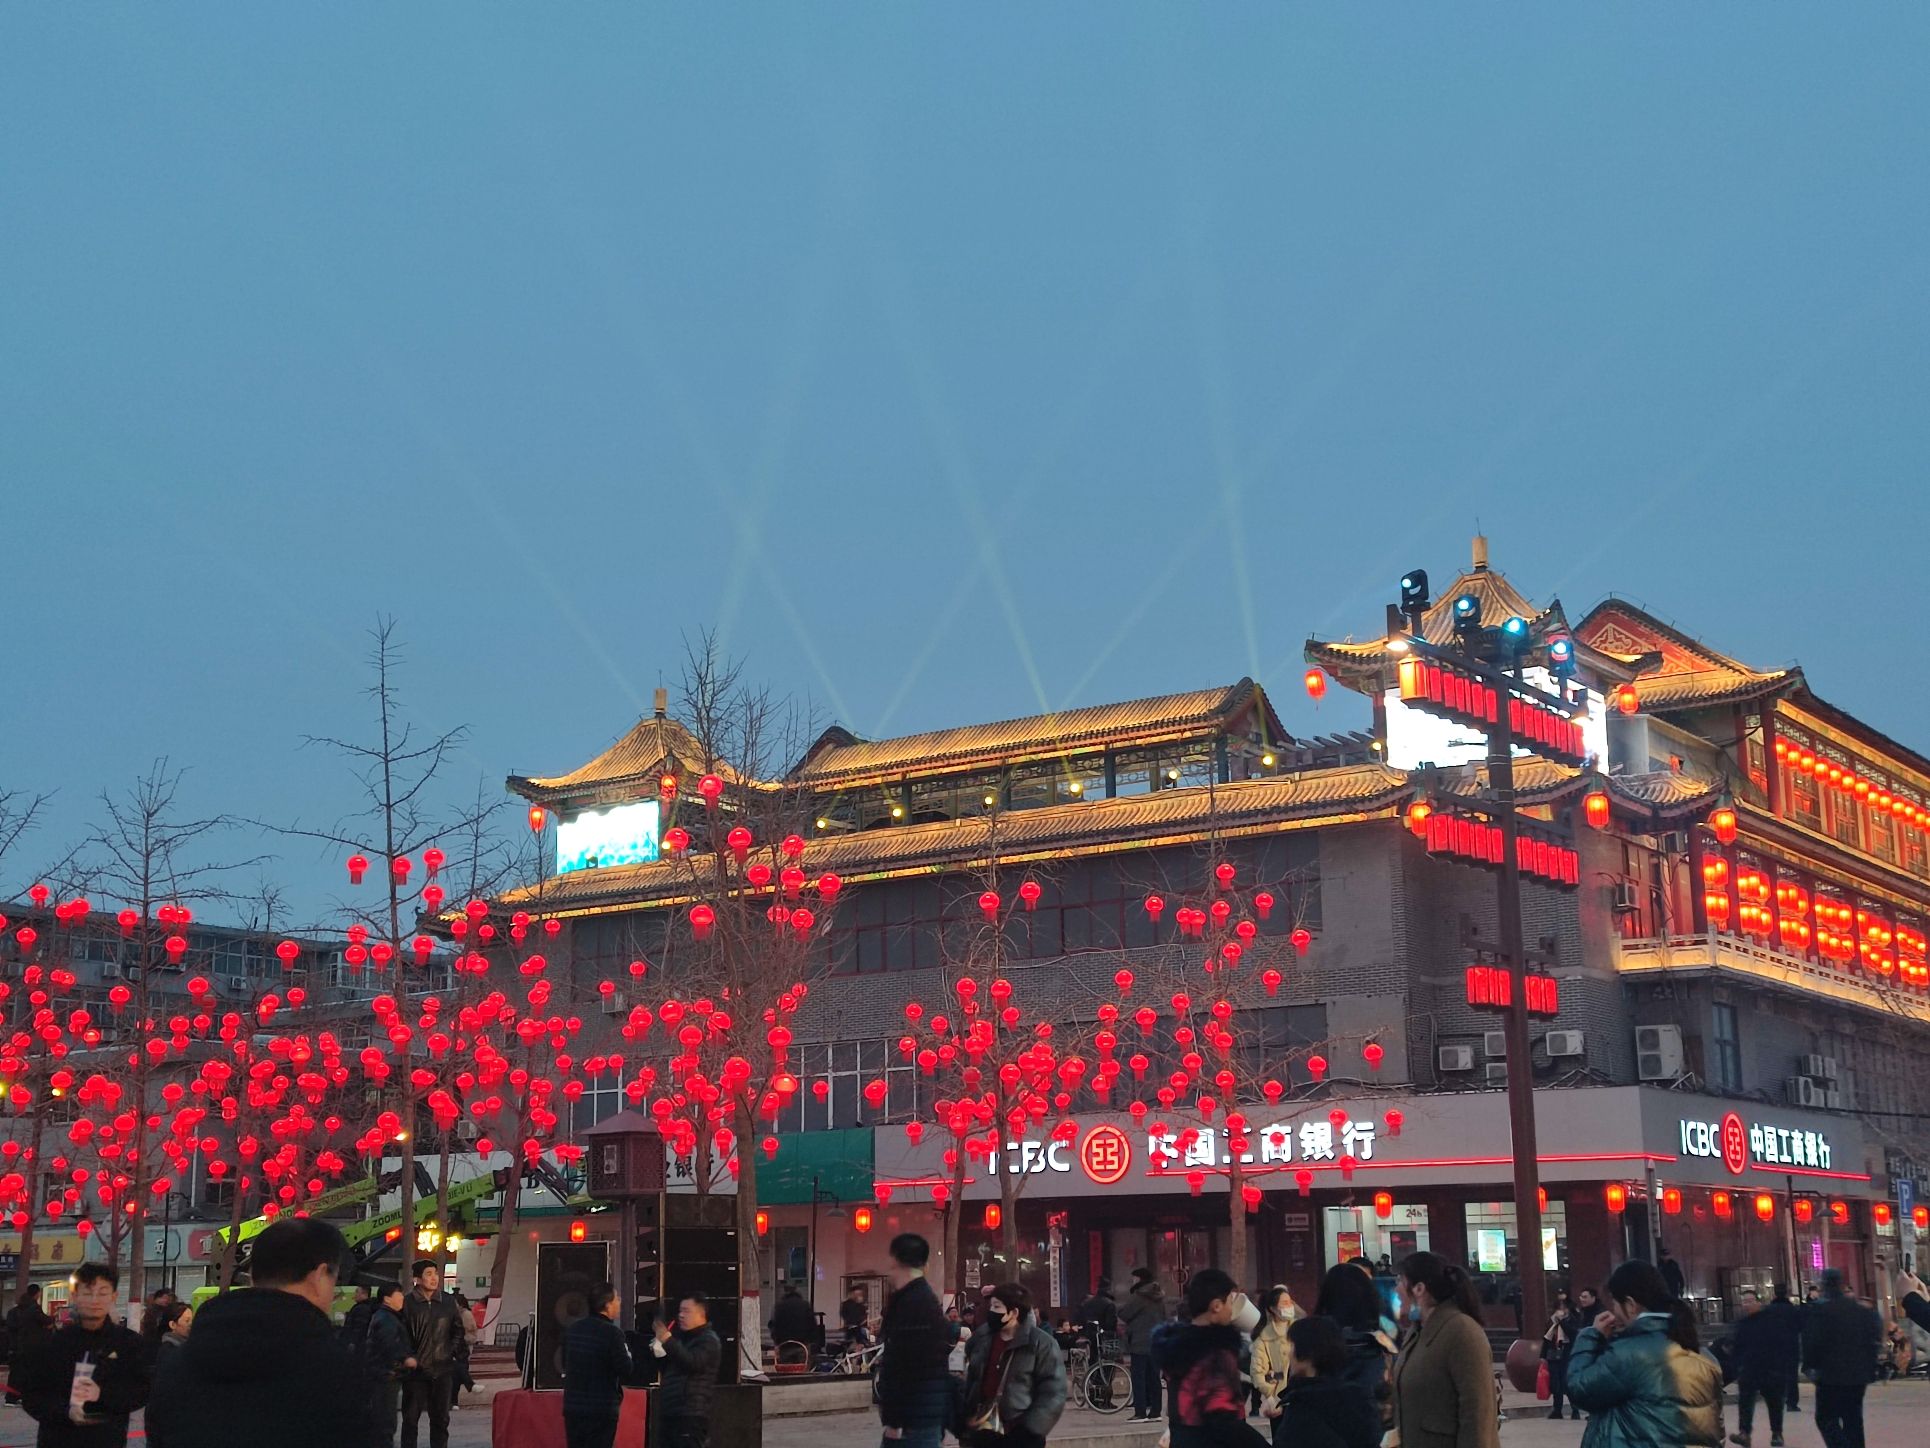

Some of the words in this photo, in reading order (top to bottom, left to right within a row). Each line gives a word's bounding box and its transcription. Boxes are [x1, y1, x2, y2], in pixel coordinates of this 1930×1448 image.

[1680, 1120, 1721, 1158] ICBC
[1750, 1123, 1831, 1169] 中国工商银行
[1902, 1184, 1910, 1213] P
[372, 1203, 418, 1228] ZOOMLN
